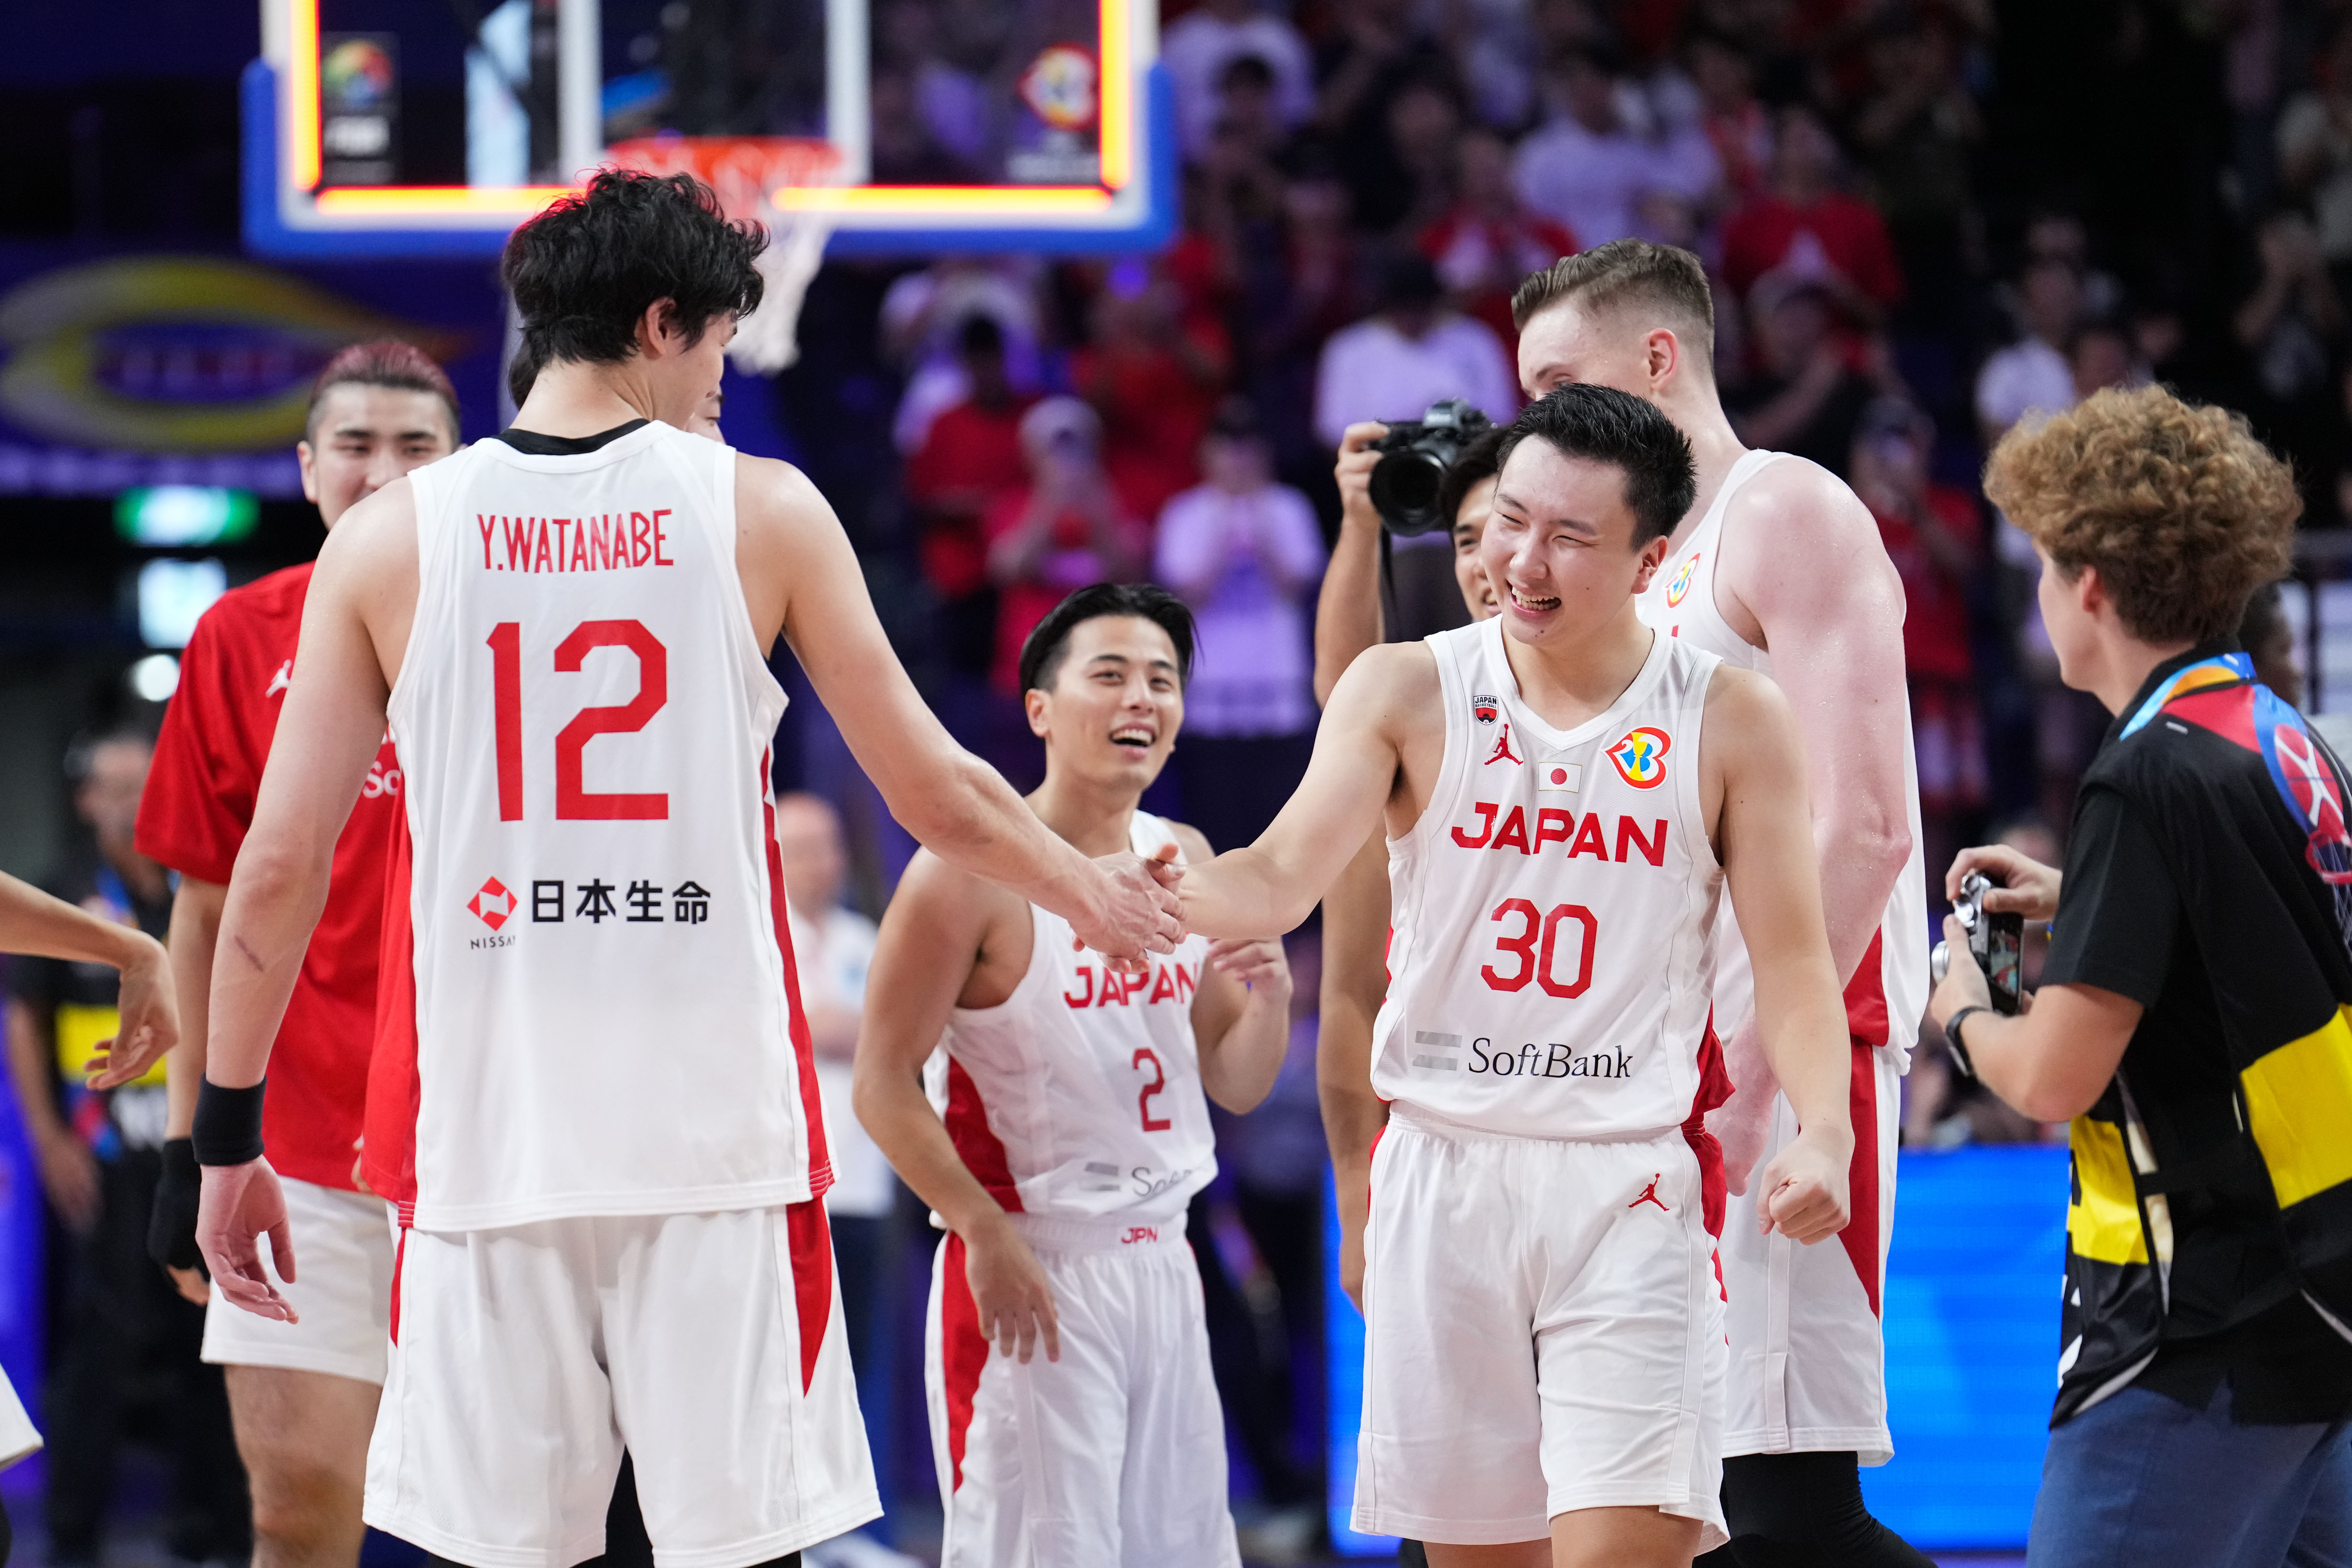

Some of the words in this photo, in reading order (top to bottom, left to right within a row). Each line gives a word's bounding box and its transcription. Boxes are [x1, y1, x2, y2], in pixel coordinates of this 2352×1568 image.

[477, 509, 674, 573] Y.WATANABE
[486, 619, 669, 822] 12
[1451, 801, 1668, 867] JAPAN
[532, 878, 711, 924] 日本生命
[470, 935, 515, 949] NISSAY
[1481, 898, 1598, 999] 30
[1064, 962, 1197, 1009] JAPAN
[1468, 1037, 1633, 1078] SoftBank
[1133, 1048, 1171, 1132] 2
[1122, 1228, 1158, 1244] JPN
